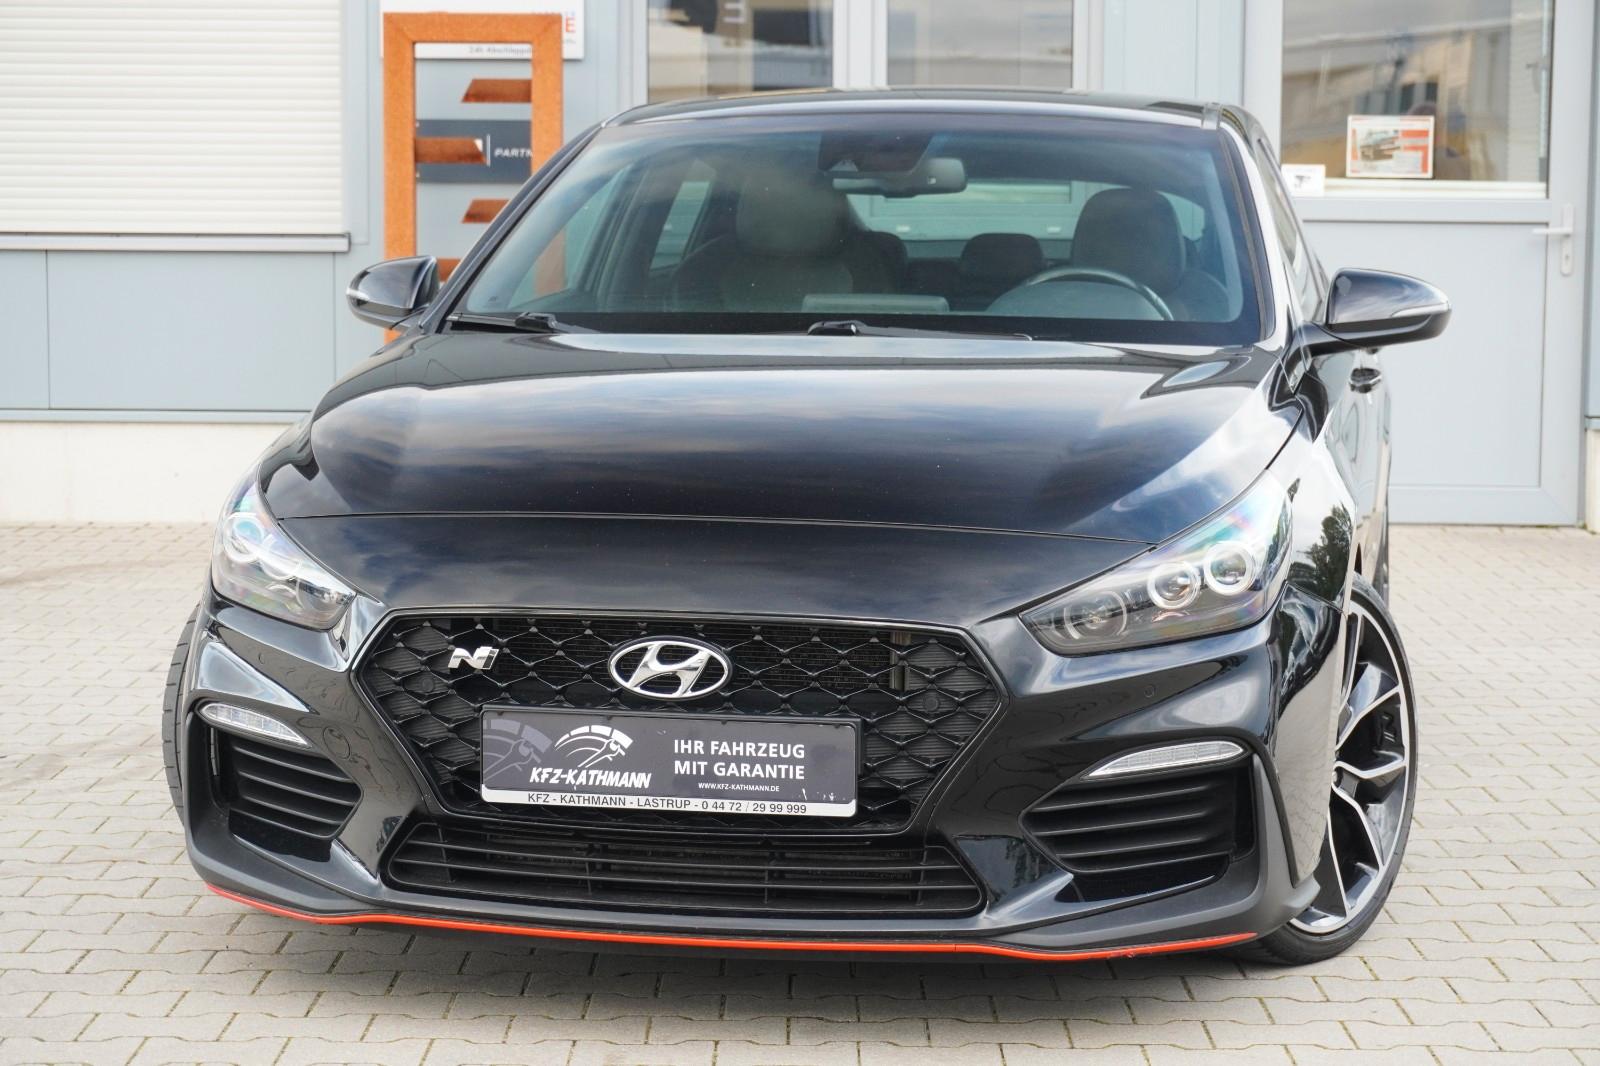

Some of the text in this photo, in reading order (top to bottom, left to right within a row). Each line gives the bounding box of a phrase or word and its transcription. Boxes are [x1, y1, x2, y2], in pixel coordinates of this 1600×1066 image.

[674, 739, 805, 759] IHR FAHRZEUG
[529, 766, 652, 789] KFZ-KATHMANN
[674, 760, 805, 780] MIT GARANTIE
[698, 782, 780, 792] WWW.KFZ-KATHMANN.DE
[528, 793, 550, 803] KFZ
[560, 794, 626, 807] KATHMANN
[637, 797, 691, 809] LASTRUP
[701, 801, 708, 810] 0
[711, 801, 725, 811] 44
[729, 802, 742, 812] 72
[752, 802, 766, 813] 29
[769, 803, 783, 814] 99
[786, 804, 807, 814] 999
